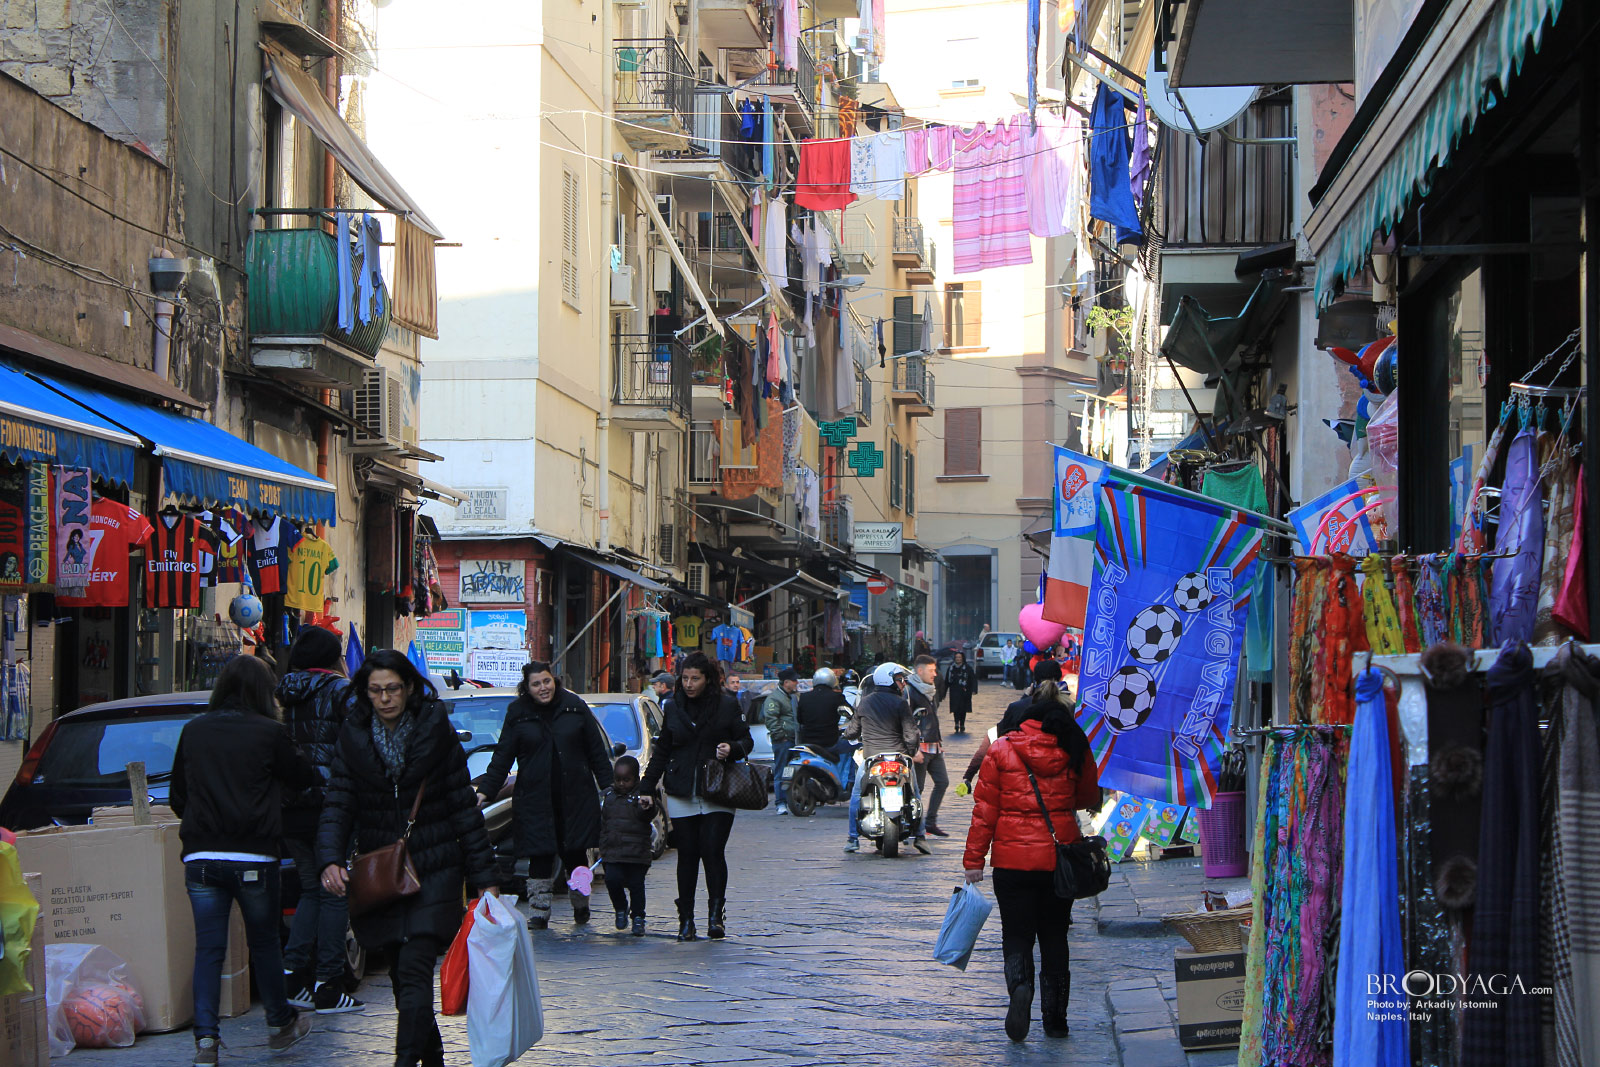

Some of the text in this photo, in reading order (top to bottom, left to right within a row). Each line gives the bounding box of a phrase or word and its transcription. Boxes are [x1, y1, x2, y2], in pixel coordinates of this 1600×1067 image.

[1, 418, 57, 456] FONTANELLA
[228, 477, 281, 506] TEAM SPORT
[30, 505, 48, 552] PEACE
[164, 549, 178, 561] Fly
[264, 549, 275, 558] Fly
[62, 563, 88, 574] LADY
[148, 560, 197, 573] Emirates
[298, 560, 322, 596] 10
[683, 624, 696, 638] 10
[443, 643, 463, 652] SALUTE
[477, 661, 499, 671] ERNESTO
[501, 661, 507, 671] DI
[51, 887, 66, 895] APEL
[84, 916, 90, 925] 12
[54, 927, 96, 939] MADE IN CHINA
